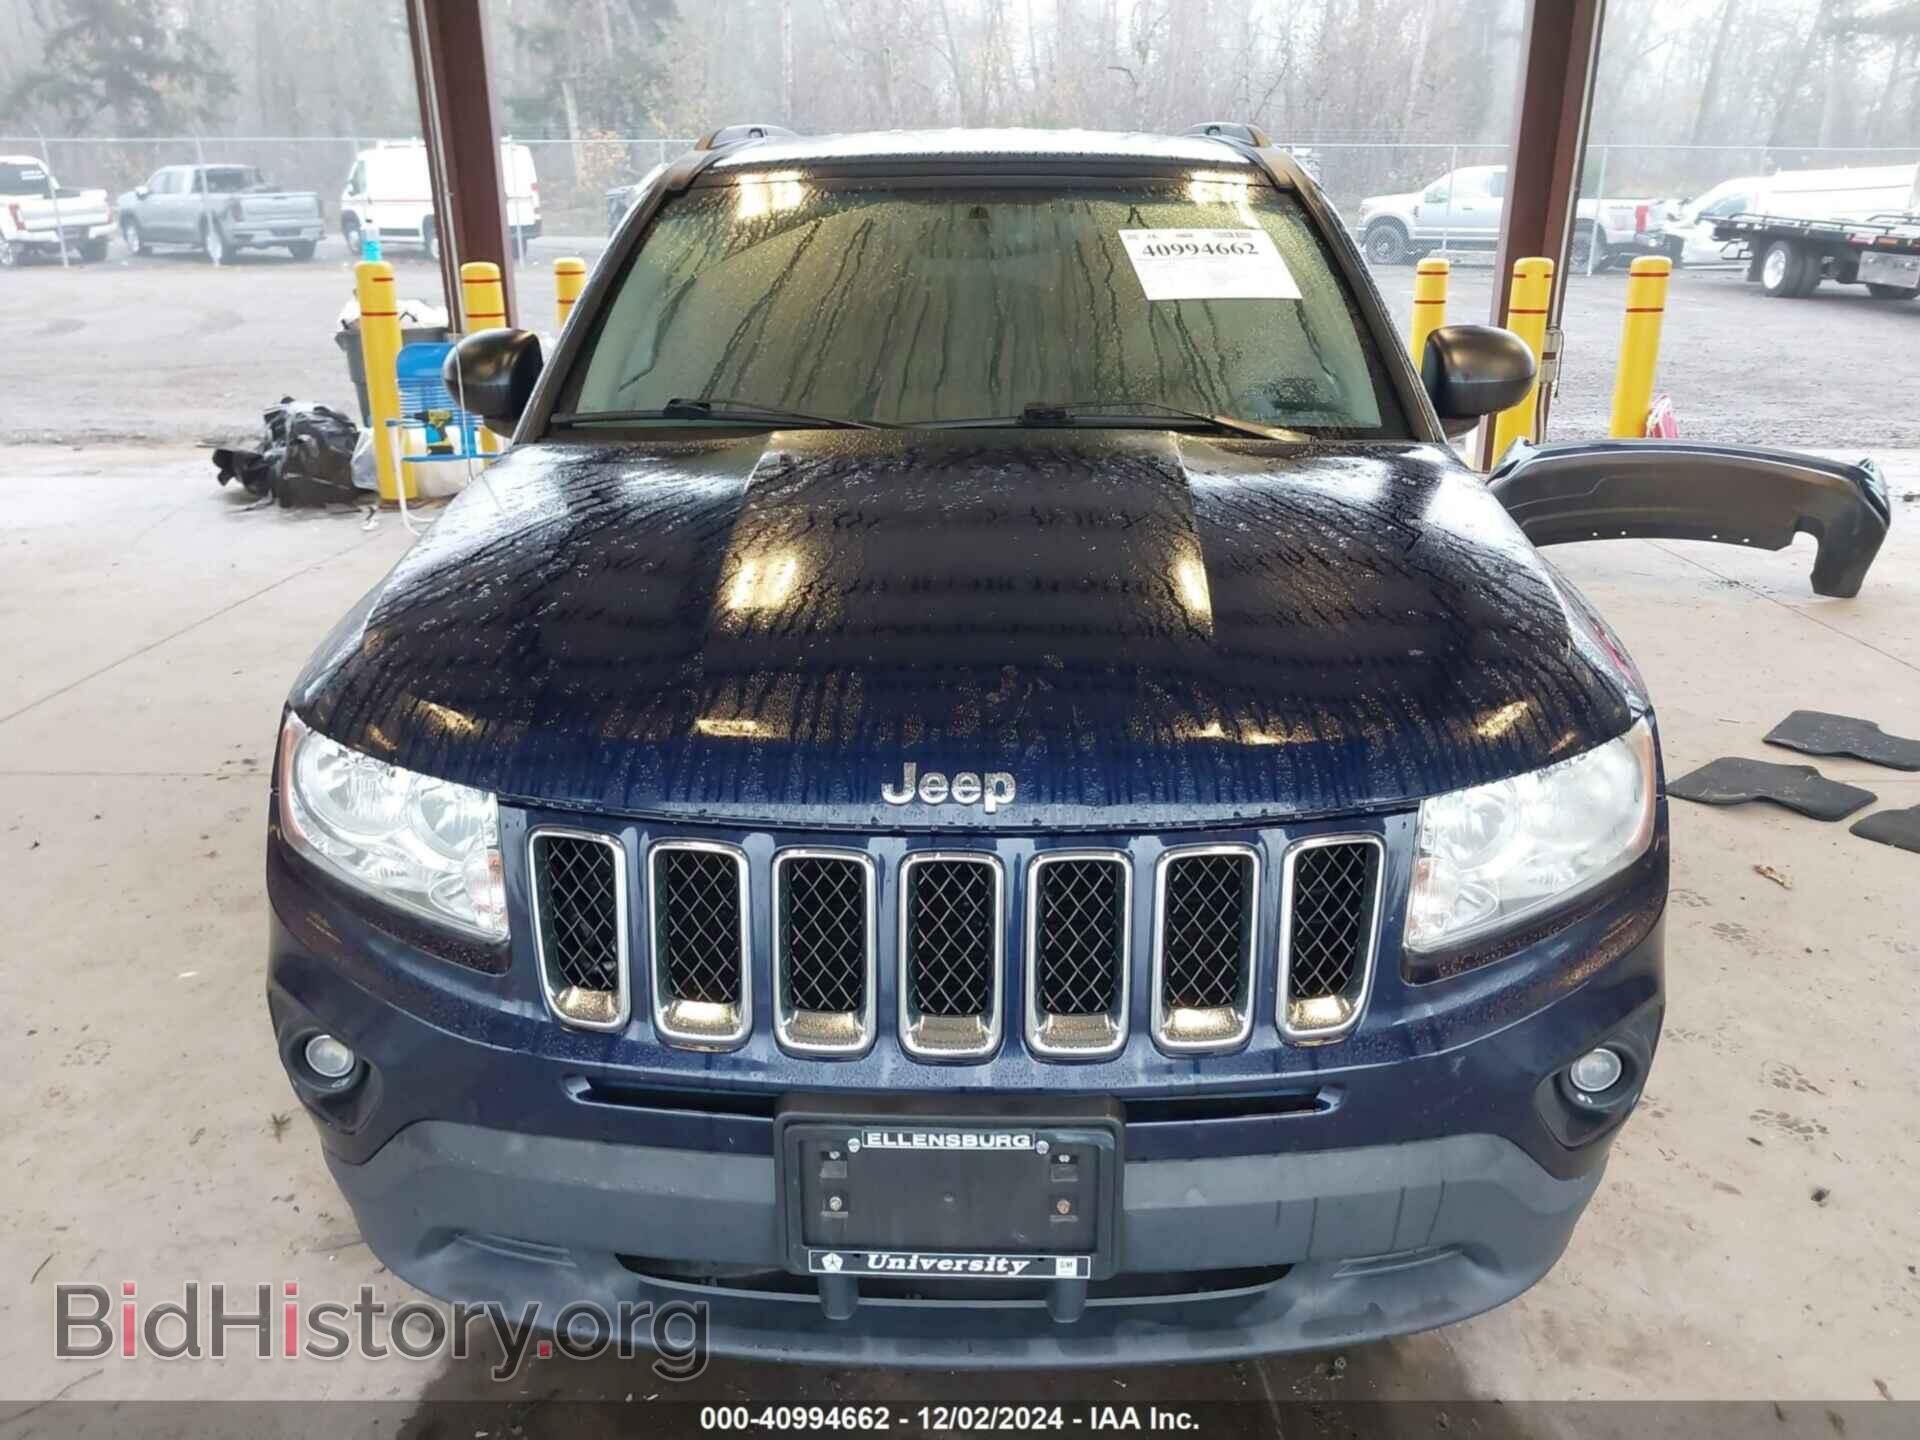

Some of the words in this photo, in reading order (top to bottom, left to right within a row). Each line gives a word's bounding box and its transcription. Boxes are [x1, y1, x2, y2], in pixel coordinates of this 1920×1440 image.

[1142, 242, 1259, 257] 40994662
[881, 762, 1016, 813] Jeep
[866, 1132, 1032, 1148] ELLENSBURG
[866, 1253, 1030, 1276] University
